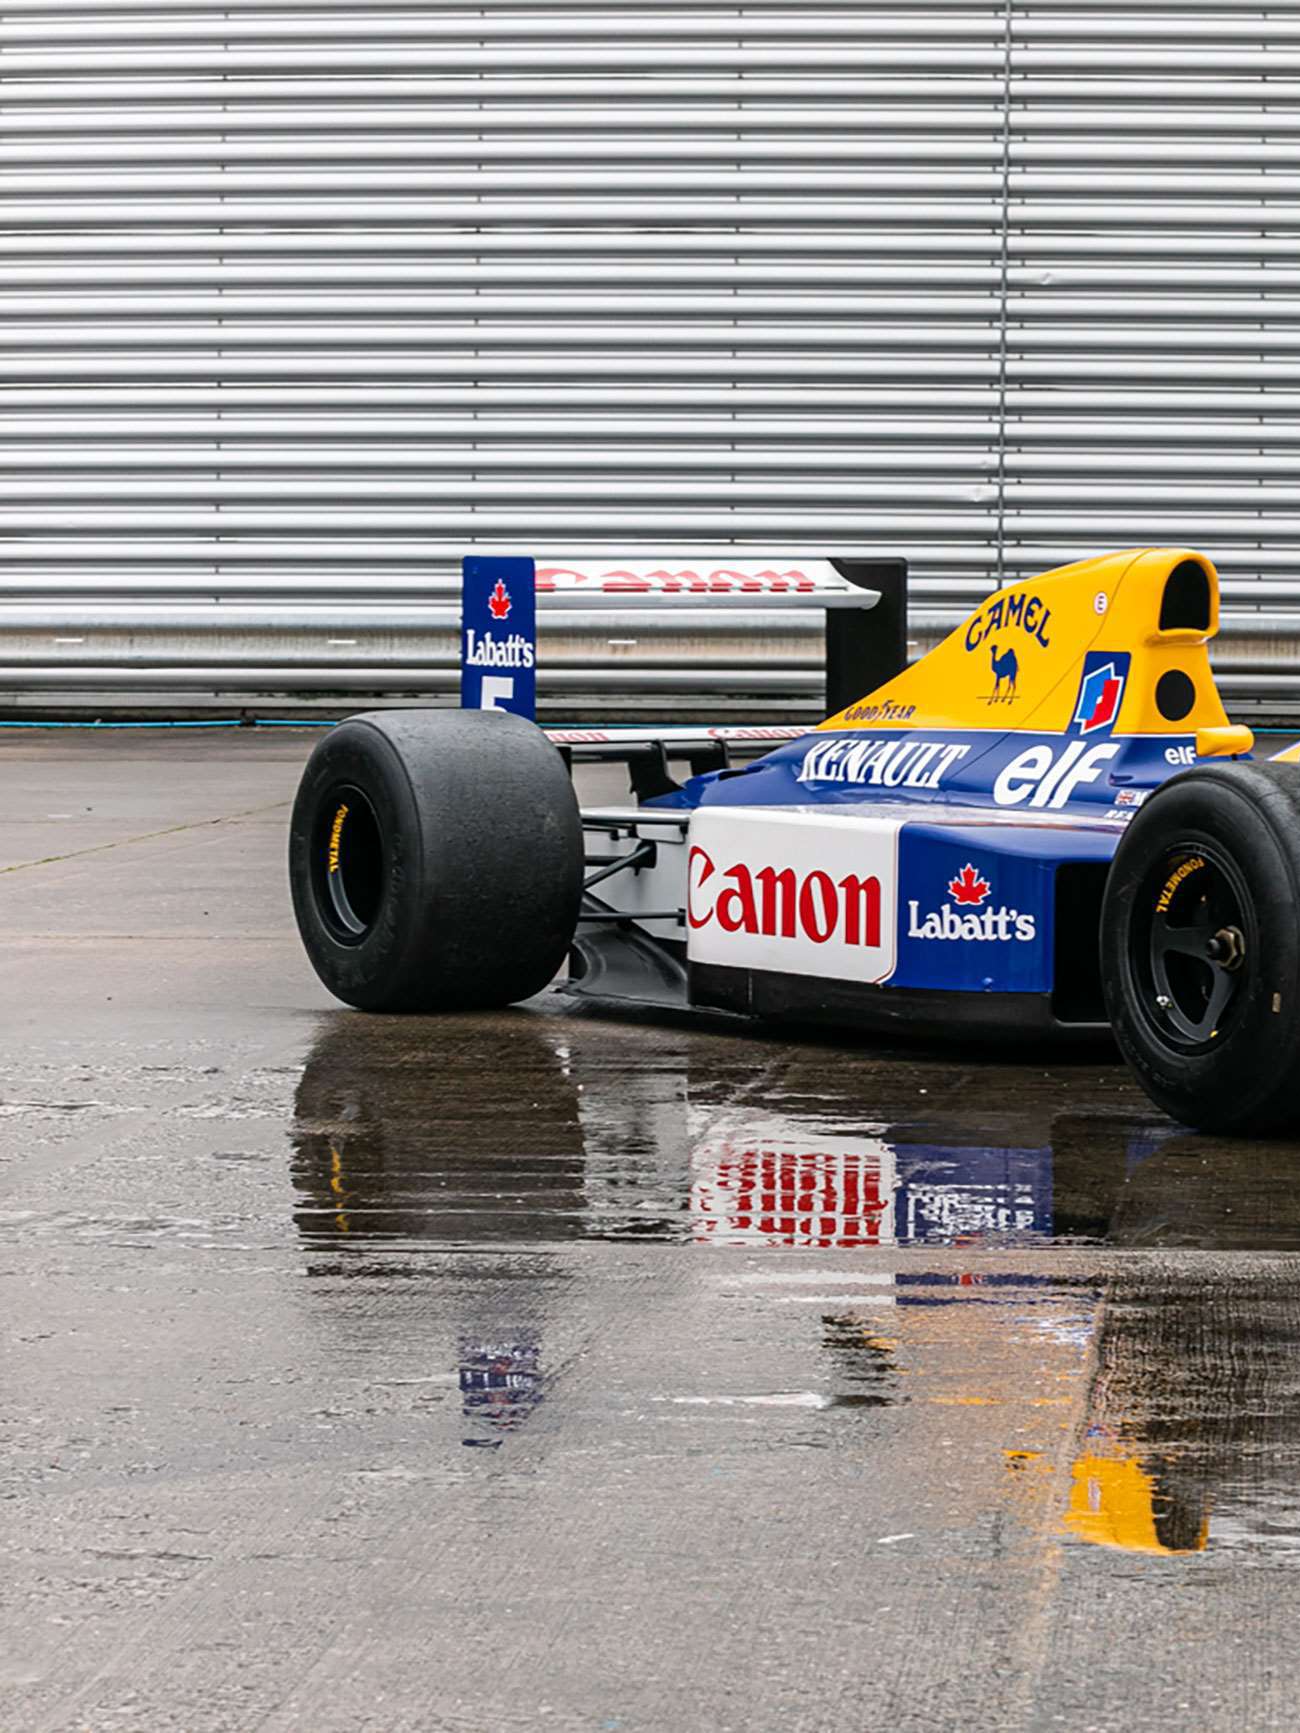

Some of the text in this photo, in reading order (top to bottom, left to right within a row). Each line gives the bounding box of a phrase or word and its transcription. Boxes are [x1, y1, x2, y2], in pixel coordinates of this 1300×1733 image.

[466, 629, 534, 668] Labatt's
[965, 593, 1051, 652] CAMEL
[796, 739, 970, 789] RENAULT
[994, 740, 1120, 809] elf
[688, 845, 882, 949] Canon
[1156, 857, 1205, 913] FONDMETAL
[908, 900, 1036, 942] Labatt's
